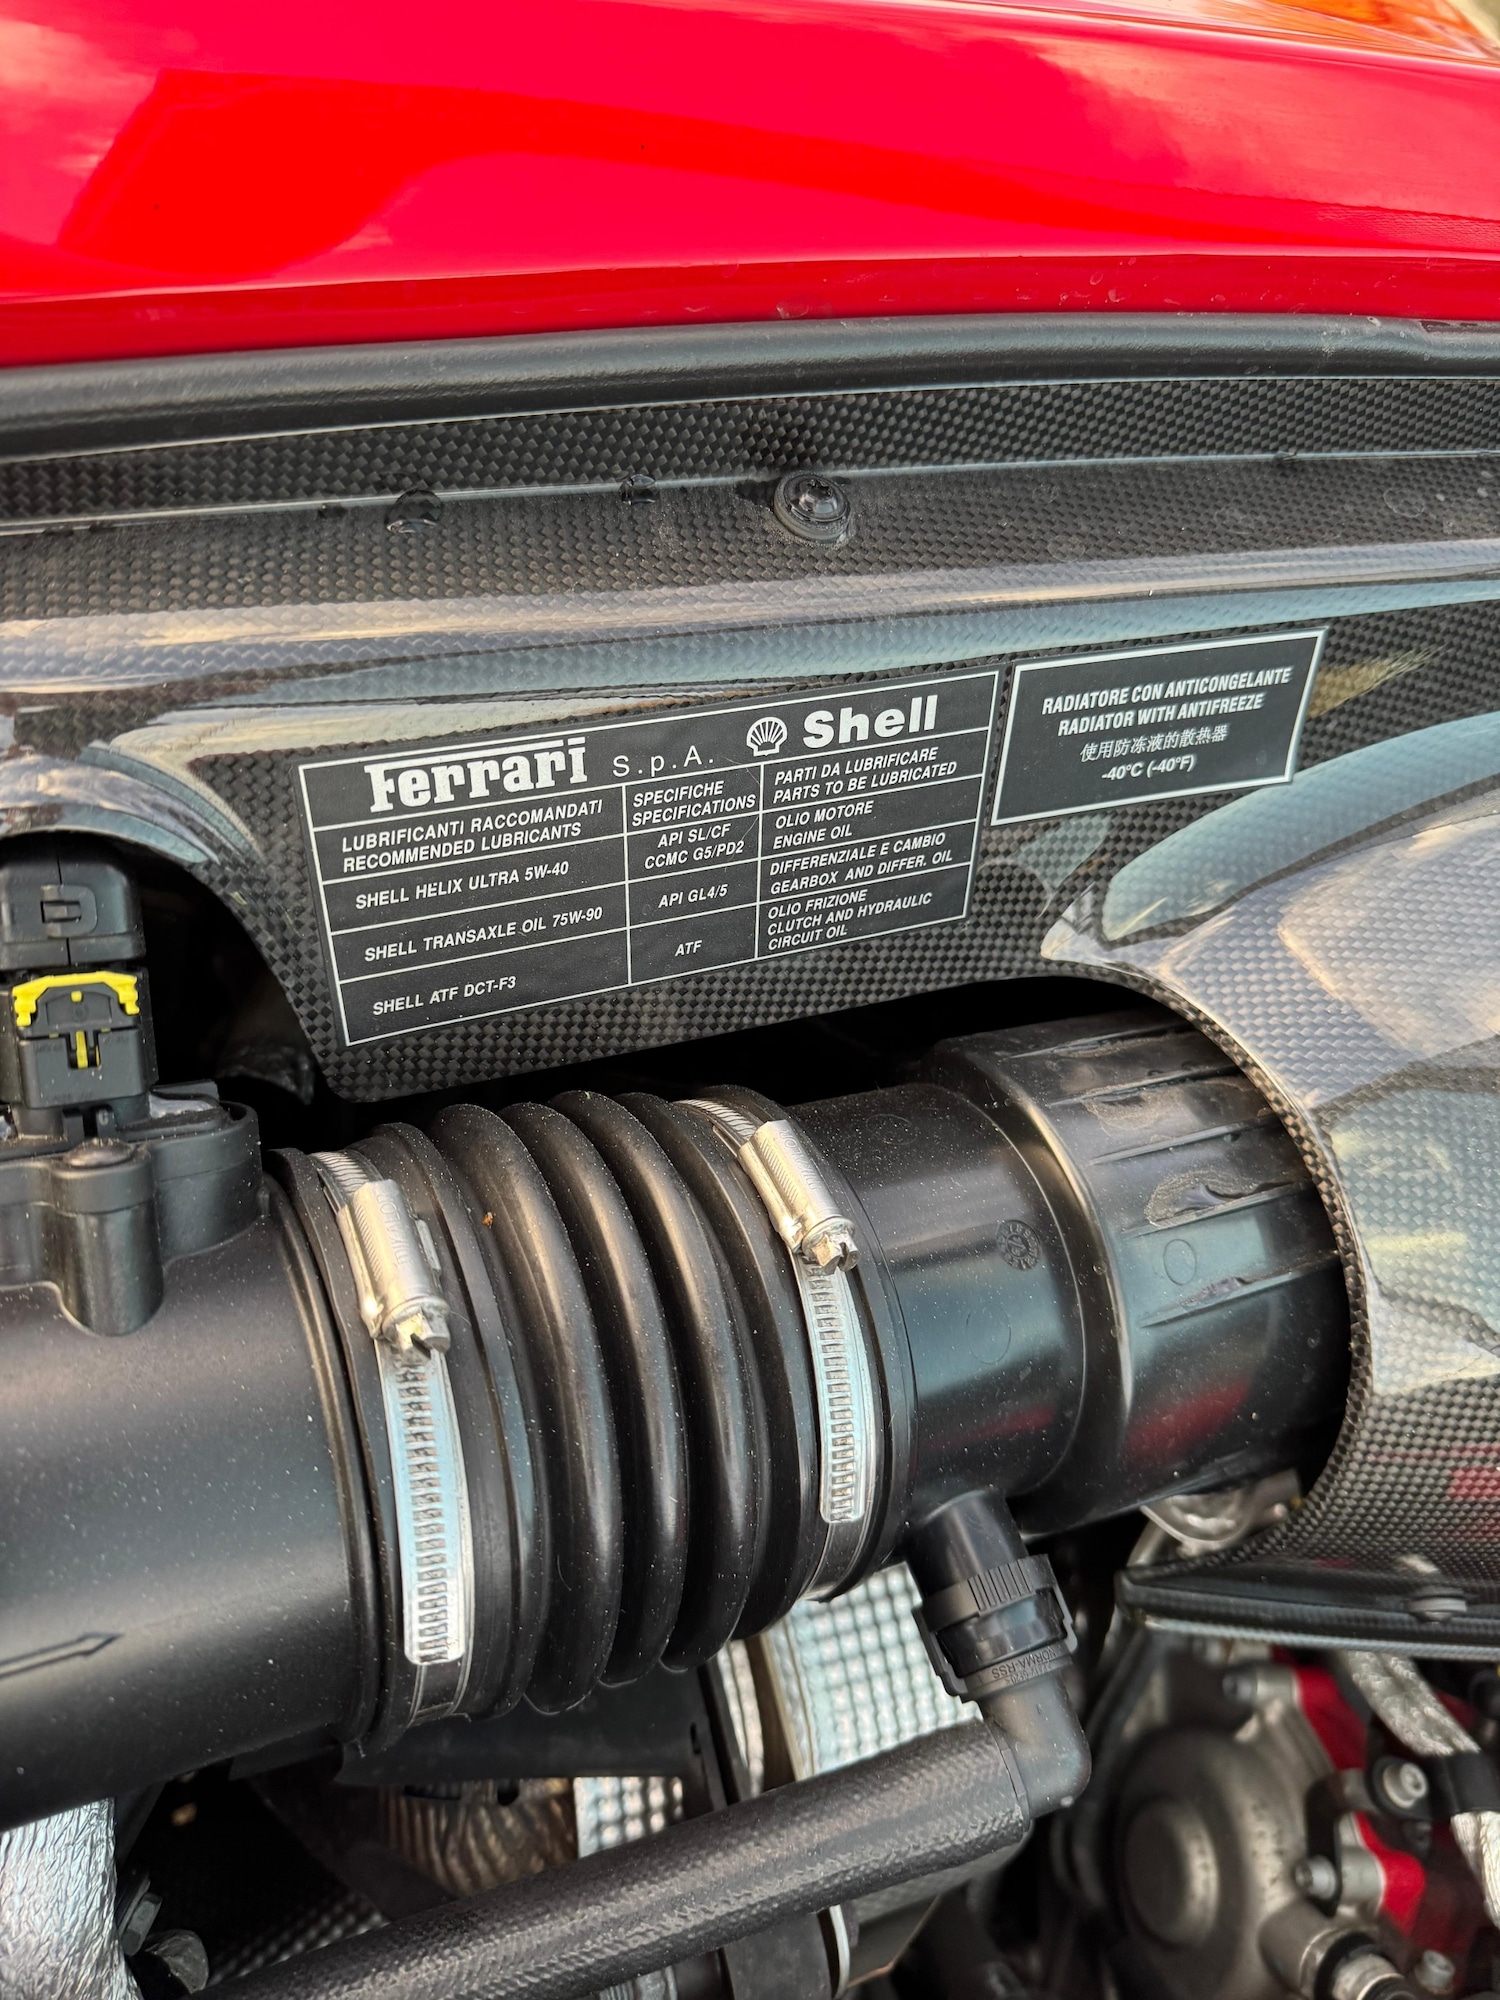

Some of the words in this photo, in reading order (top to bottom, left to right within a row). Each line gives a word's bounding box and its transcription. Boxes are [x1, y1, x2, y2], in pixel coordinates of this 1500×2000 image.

[1042, 686, 1129, 715] RADIATORE
[1131, 682, 1163, 702] CON
[1164, 666, 1293, 698] ANTICONGELANTE
[802, 695, 938, 749] Shell
[1058, 708, 1134, 737] RADIATOR
[1137, 705, 1175, 725] WITH
[1177, 692, 1266, 721] ANTIFREEZE
[1080, 724, 1229, 762] 使用防冻液的散热器
[364, 737, 587, 813] Ferrari
[773, 785, 820, 803] PARTS
[825, 782, 843, 797] TO
[847, 777, 866, 793] BE
[870, 761, 957, 788] LUBRICATED
[774, 767, 816, 785] PARTI
[821, 762, 840, 778] DA
[845, 748, 938, 774] LUBRIFICARE
[632, 794, 756, 827] SPECIFICATIONS
[633, 781, 724, 808] SPECIFICHE
[342, 820, 464, 853] LUBRIFICANTI
[470, 799, 603, 833] RACCOMANDATI
[775, 812, 810, 830] OLIO
[814, 800, 874, 824] MOTORE
[343, 839, 475, 872] RECOMMENDED
[481, 822, 582, 851] LUBRICANTS
[644, 850, 689, 870] CCMC
[693, 841, 745, 862] G5/PD2
[658, 832, 683, 848] API
[687, 824, 731, 843] SL/CF
[769, 845, 877, 876] DIFFERENZIALE
[879, 841, 890, 857] E
[892, 832, 946, 855] CAMBIO
[773, 828, 825, 850] ENGINE
[830, 824, 852, 840] OIL
[356, 889, 409, 910] SHELL
[416, 879, 462, 900] HELIX
[468, 868, 519, 891] ULTRA
[525, 861, 569, 882] 5W-40
[770, 871, 838, 895] GEARBOX
[844, 863, 873, 881] AND
[877, 856, 927, 875] DIFFER.
[932, 850, 953, 865] OIL
[658, 893, 684, 908] API
[687, 884, 729, 904] GL4/5
[767, 915, 821, 936] CLUTCH
[825, 907, 853, 925] AND
[857, 892, 932, 918] HYDRAULIC
[768, 902, 800, 920] OLIO
[805, 889, 868, 913] FRIZIONE
[364, 940, 417, 962] SHELL
[424, 922, 517, 951] TRANSAXLE
[522, 916, 547, 934] OIL
[552, 907, 603, 928] 75W-90
[675, 940, 702, 957] ATF
[768, 929, 822, 950] CIRCUIT
[826, 924, 848, 940] OIL
[372, 994, 424, 1016] SHELL
[429, 987, 459, 1005] ATF
[463, 976, 516, 998] DCT-F3
[992, 1646, 1057, 1679] NORMA-RSS
